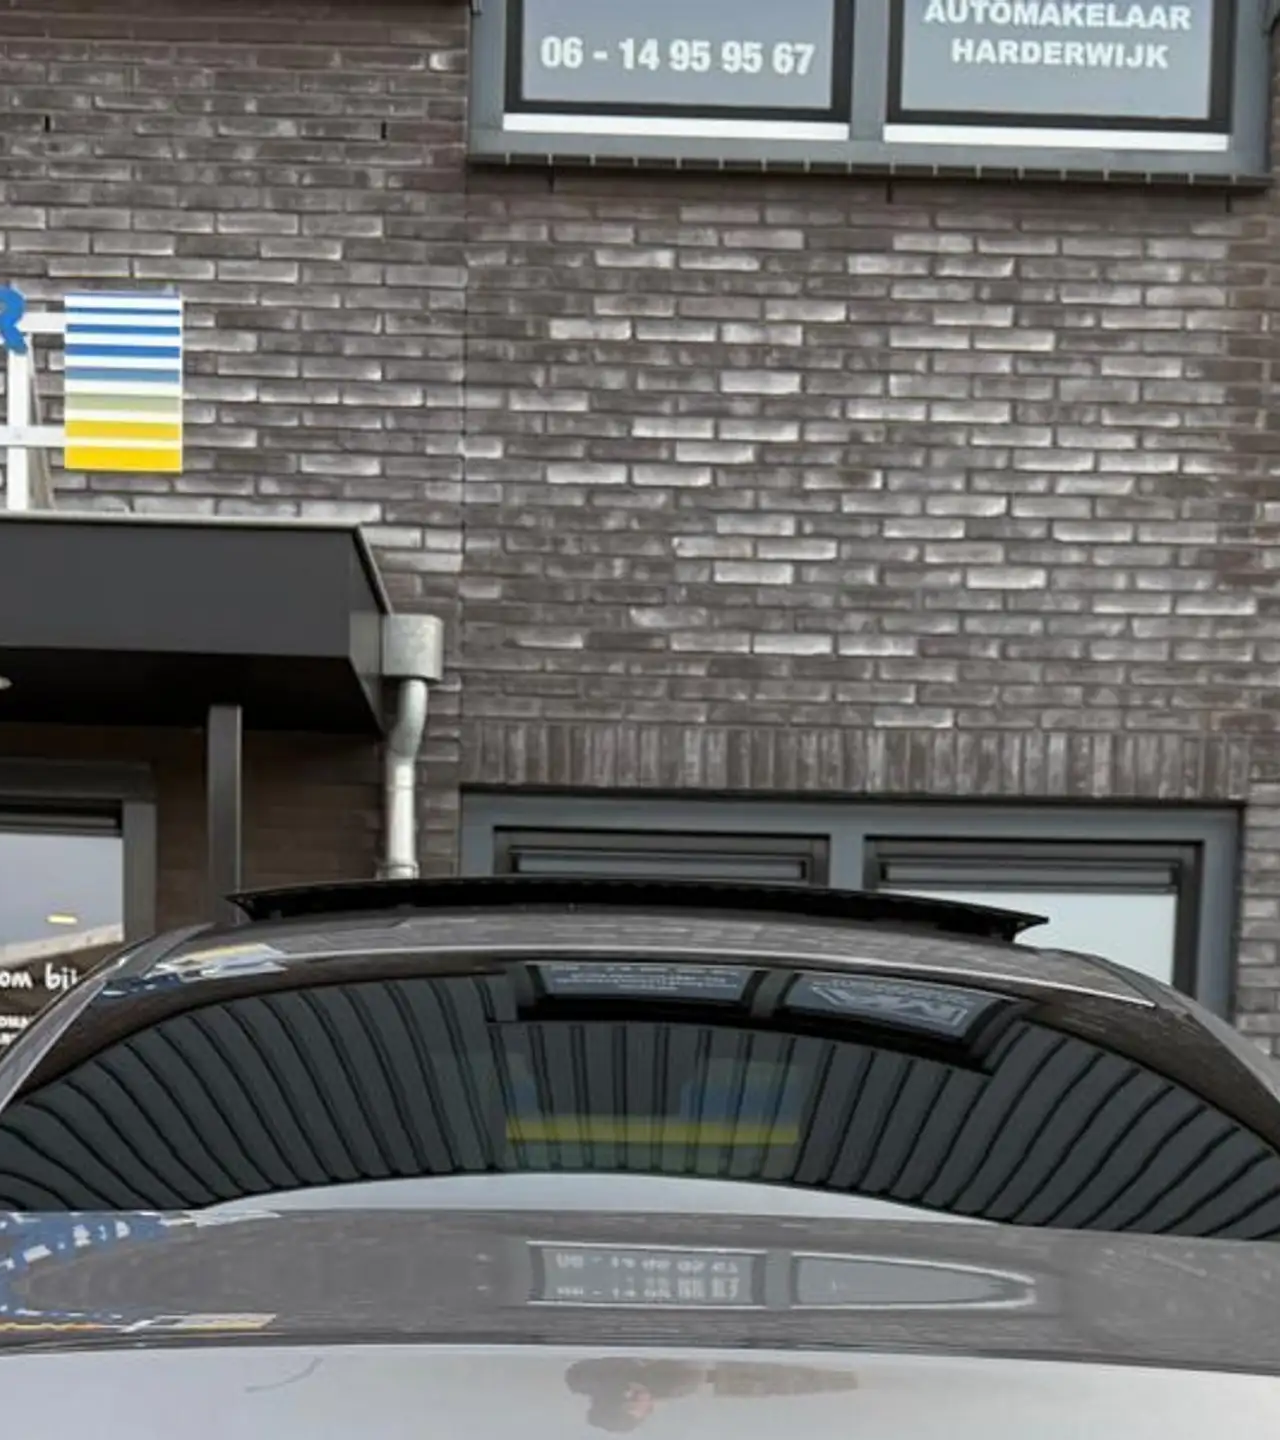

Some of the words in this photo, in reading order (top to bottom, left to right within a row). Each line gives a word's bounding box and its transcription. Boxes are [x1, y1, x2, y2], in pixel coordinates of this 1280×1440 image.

[924, 0, 1192, 30] AUTOMAKELAAR
[540, 36, 584, 68] 06
[593, 51, 608, 60] -
[619, 38, 661, 70] 14
[669, 40, 710, 72] 95
[721, 41, 763, 73] 95
[772, 43, 816, 75] 67
[951, 37, 1170, 69] HARDERWIJK
